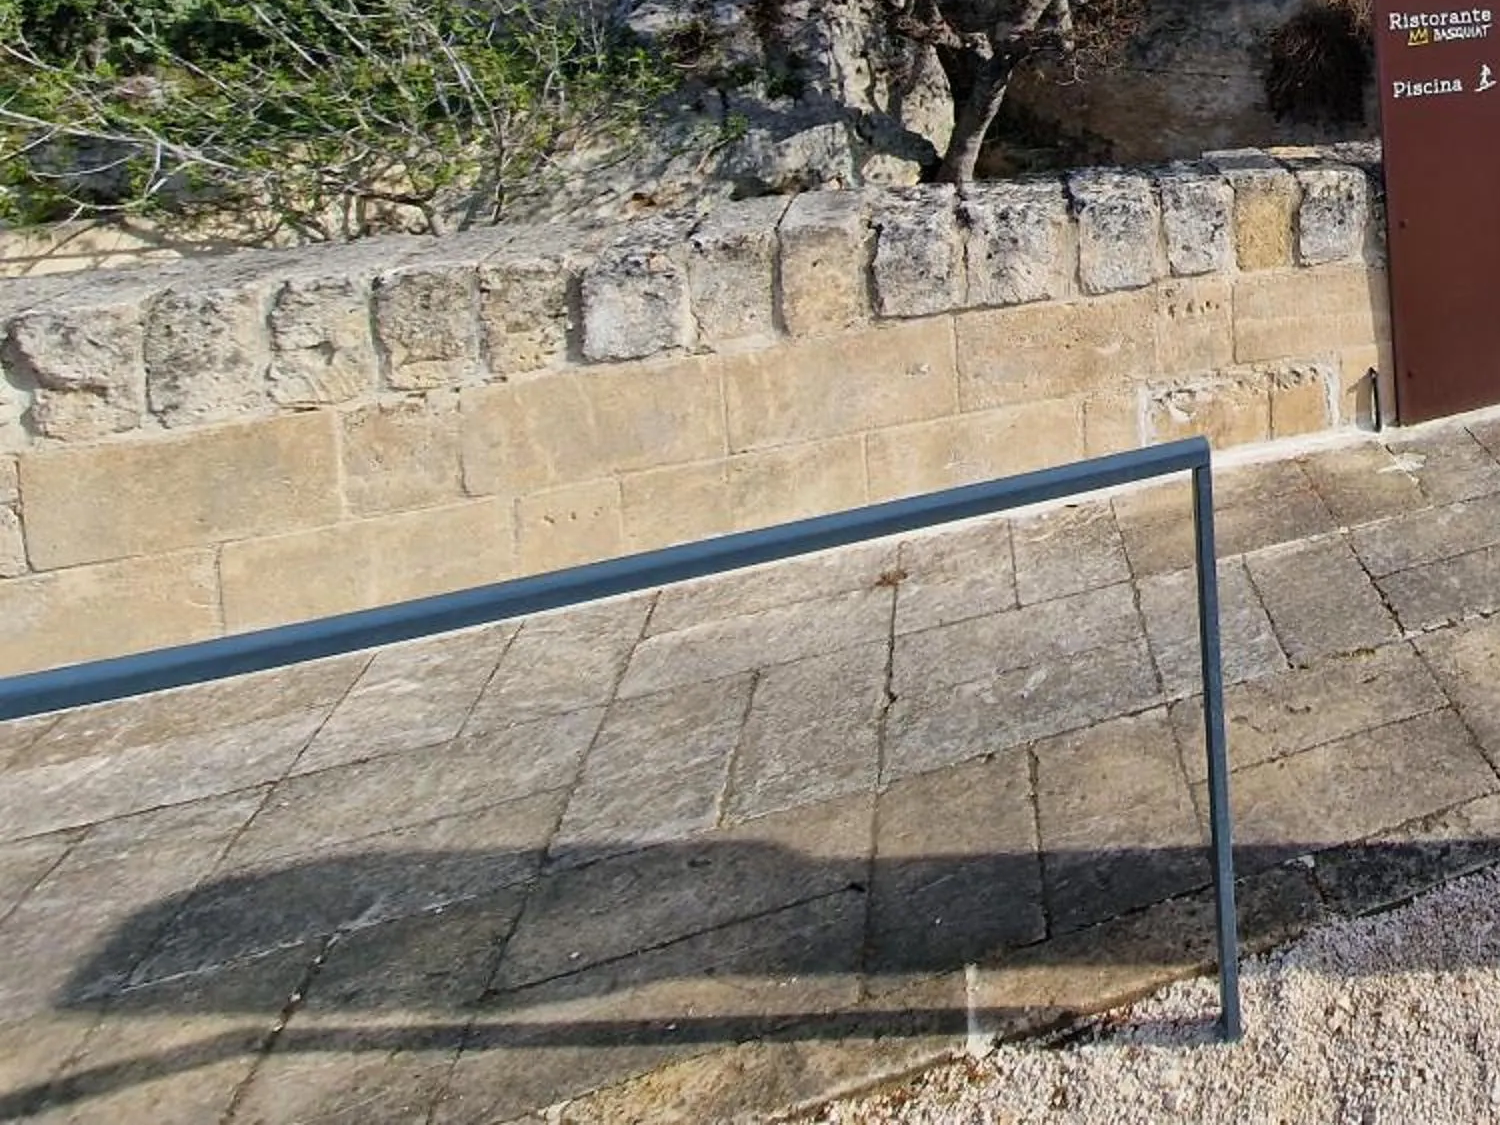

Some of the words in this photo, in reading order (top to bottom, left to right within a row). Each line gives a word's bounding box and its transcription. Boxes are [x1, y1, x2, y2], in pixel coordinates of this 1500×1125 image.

[1388, 8, 1492, 30] Ristorante
[1432, 24, 1493, 42] BASQUIAT
[1392, 79, 1463, 98] Piscina
